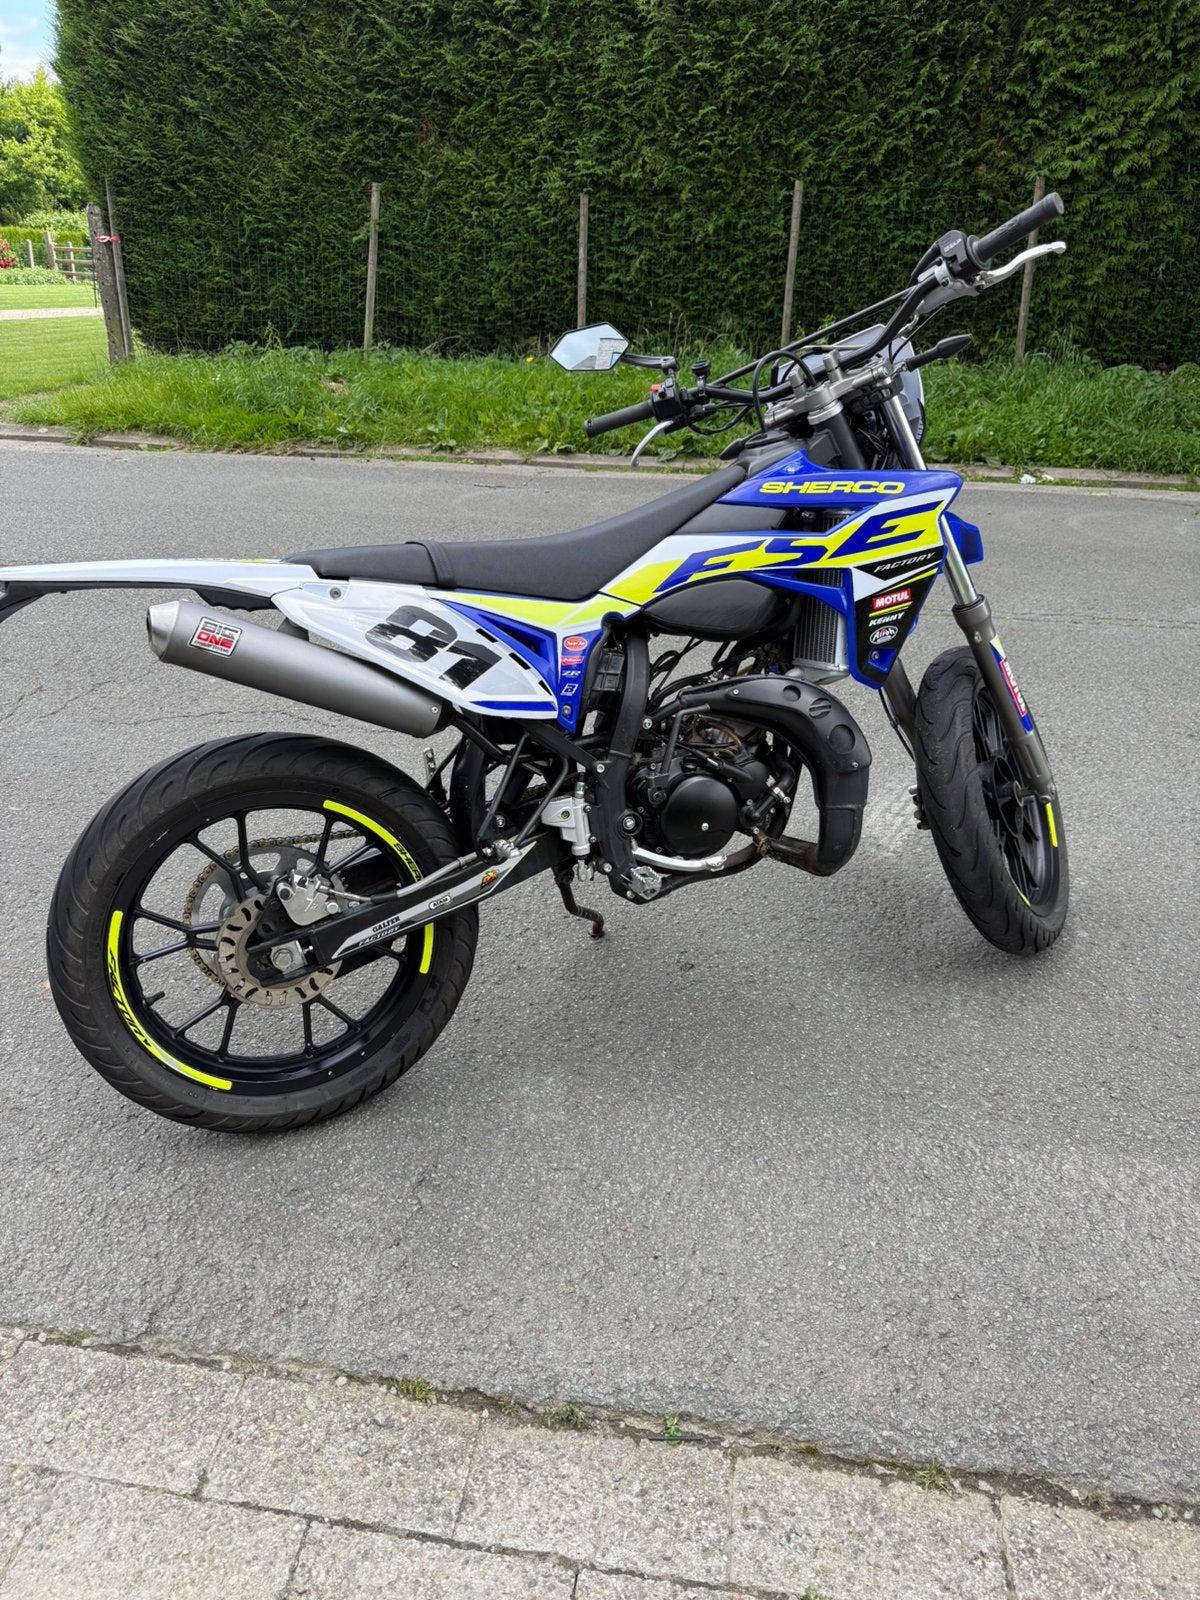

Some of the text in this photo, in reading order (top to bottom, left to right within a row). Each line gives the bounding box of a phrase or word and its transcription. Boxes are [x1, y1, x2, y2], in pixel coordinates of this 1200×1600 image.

[759, 480, 905, 494] SHERCO
[873, 552, 935, 573] FACTORY
[875, 591, 910, 608] MOTUL
[868, 612, 905, 627] KENNY
[201, 620, 239, 640] BIG
[196, 631, 234, 649] ONE
[364, 605, 503, 691] 81
[393, 843, 422, 882] SHER
[372, 916, 401, 933] GALFER
[359, 925, 401, 946] FACTORY
